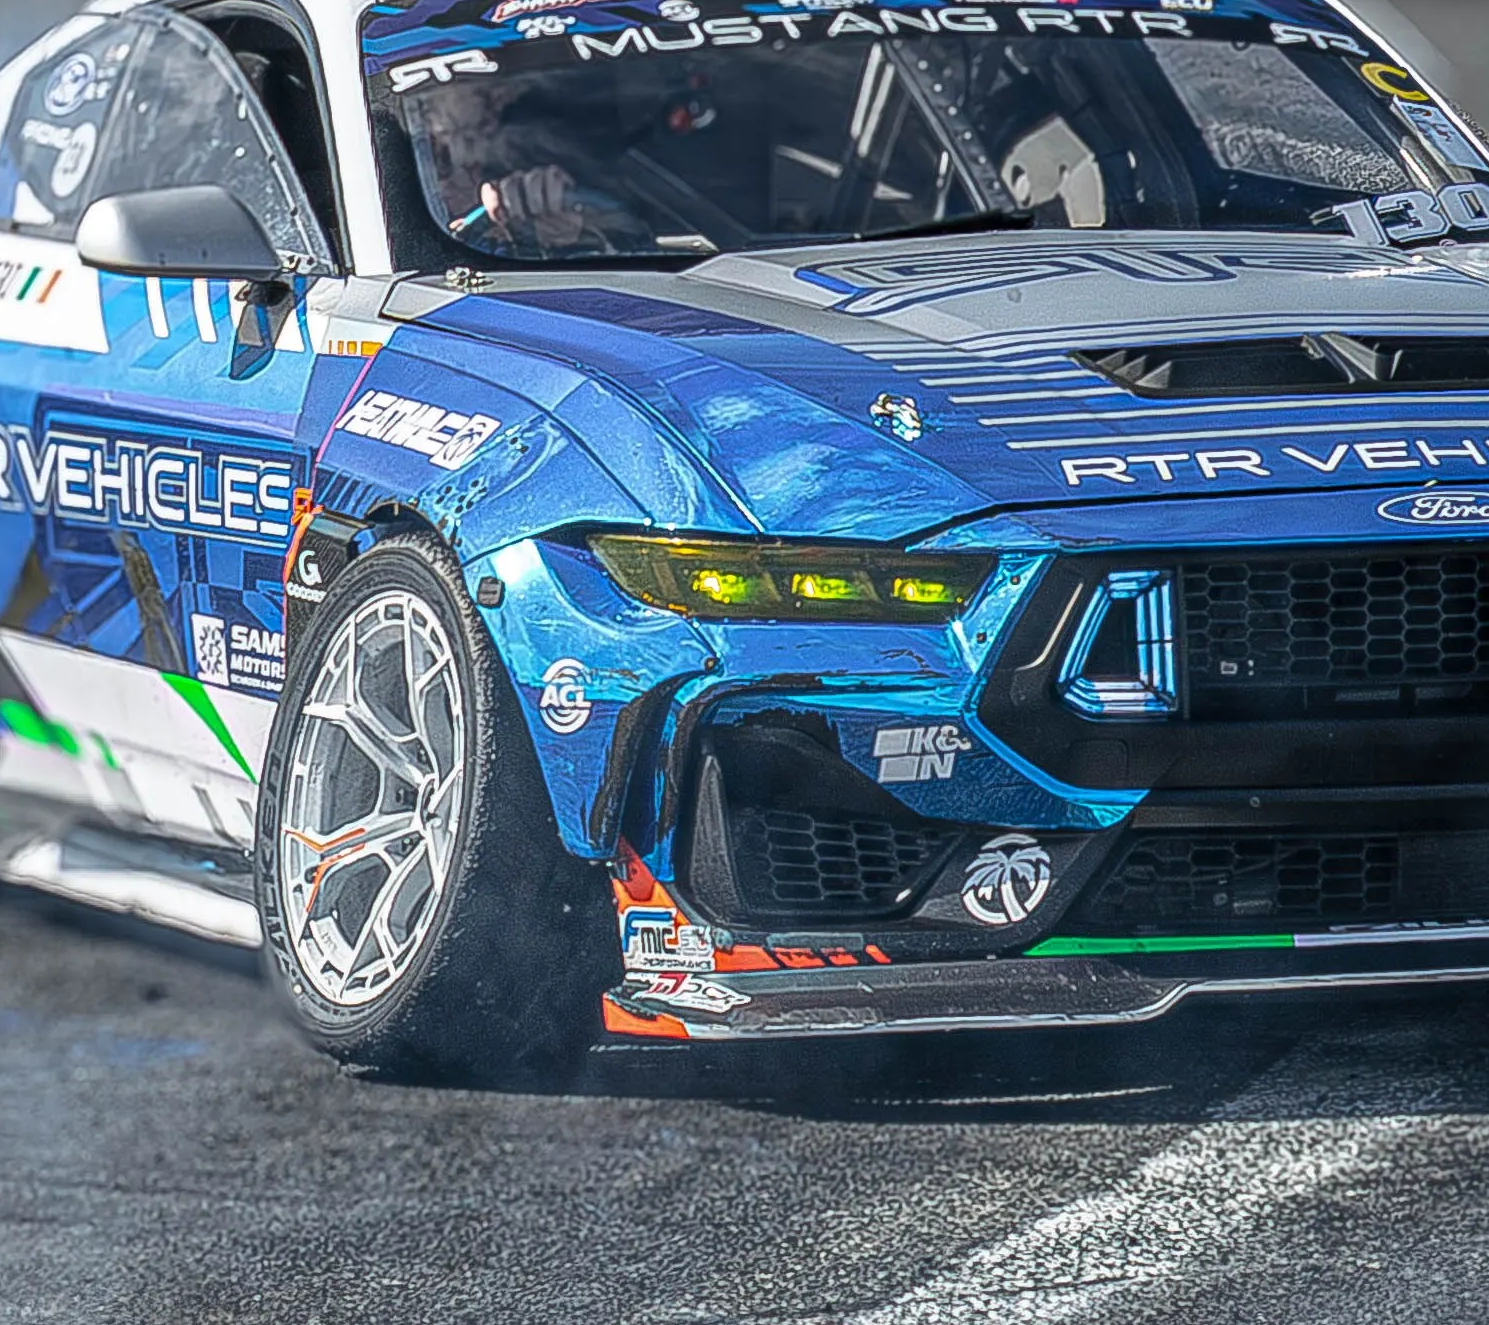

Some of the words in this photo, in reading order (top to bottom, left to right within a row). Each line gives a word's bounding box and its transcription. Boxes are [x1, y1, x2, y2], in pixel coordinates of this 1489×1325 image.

[571, 6, 998, 61] MUSTANG
[1018, 8, 1194, 38] RTR
[17, 436, 290, 538] VEHICLES
[1062, 449, 1271, 486] RTR
[540, 684, 592, 708] ACL
